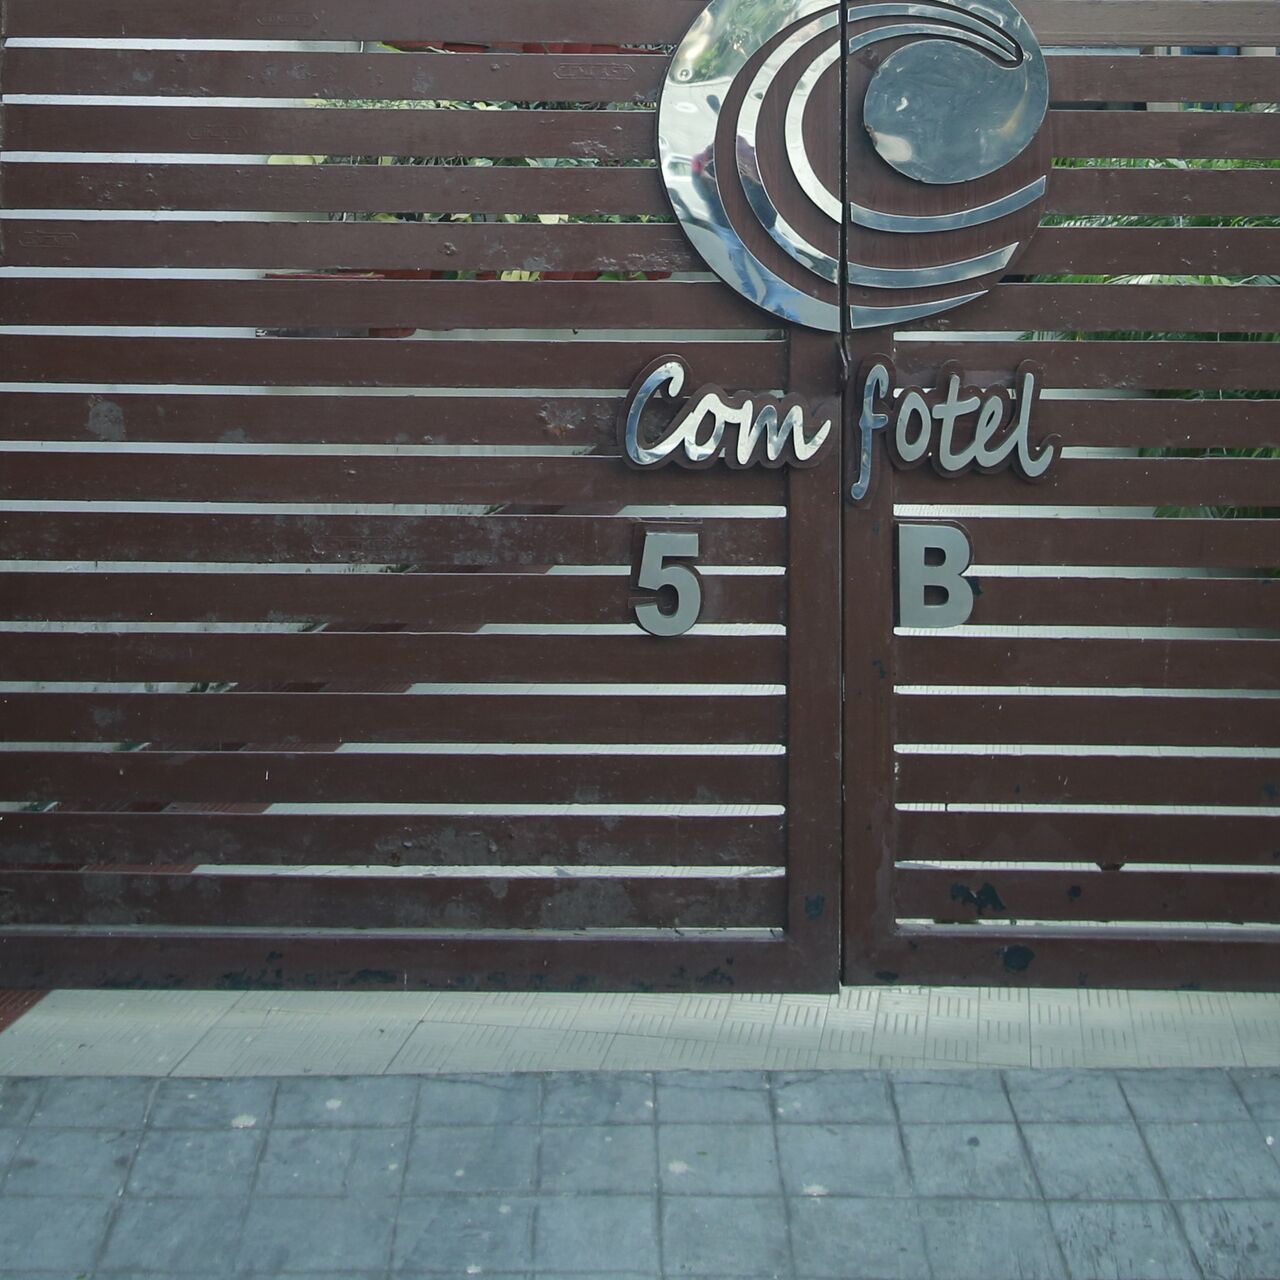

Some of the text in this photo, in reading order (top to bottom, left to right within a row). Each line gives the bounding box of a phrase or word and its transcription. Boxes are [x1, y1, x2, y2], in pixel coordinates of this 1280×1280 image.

[624, 360, 1054, 502] Com fotel
[633, 522, 974, 637] 5 B
